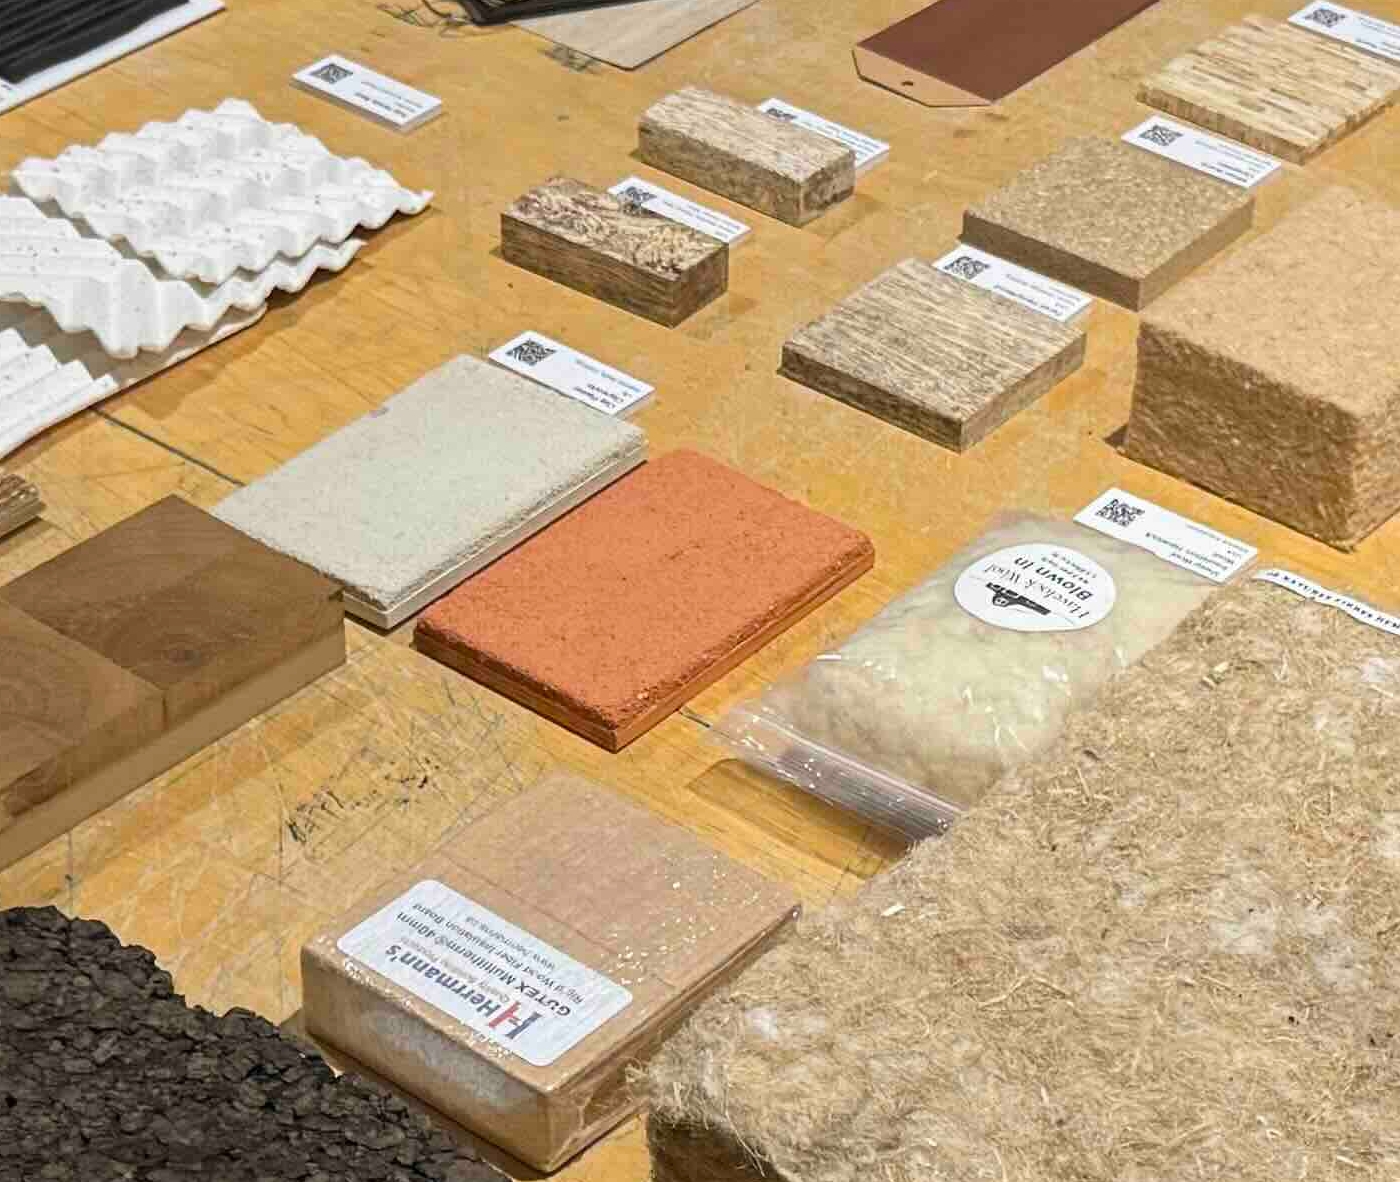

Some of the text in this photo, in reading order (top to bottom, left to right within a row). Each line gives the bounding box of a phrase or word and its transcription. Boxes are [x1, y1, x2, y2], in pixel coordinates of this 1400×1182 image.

[1011, 555, 1035, 570] In
[1031, 566, 1095, 601] Blown
[394, 911, 436, 940] 40mm
[381, 942, 499, 1019] Herrmann's
[515, 980, 570, 1017] GUTEX
